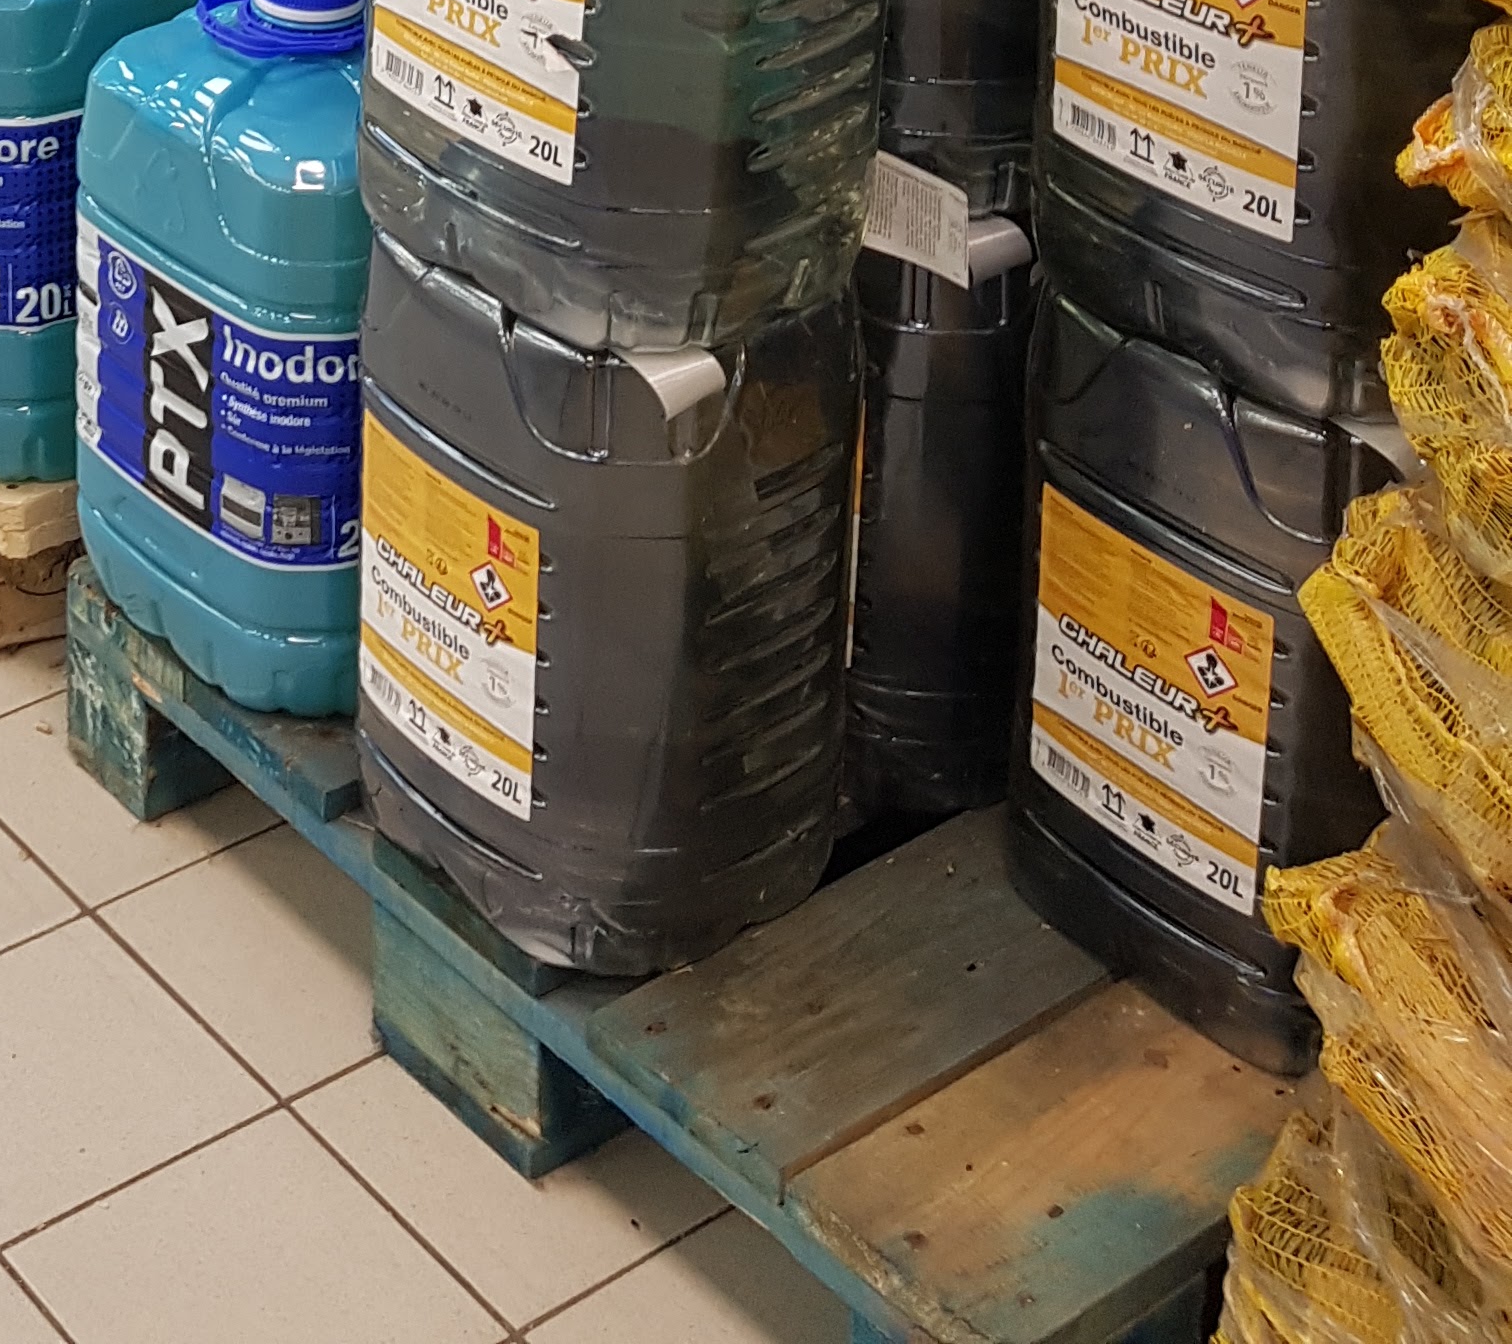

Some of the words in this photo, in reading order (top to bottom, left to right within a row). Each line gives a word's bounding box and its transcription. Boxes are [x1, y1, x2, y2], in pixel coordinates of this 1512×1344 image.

[1081, 16, 1112, 46] 1er
[1119, 34, 1208, 100] PRIX
[528, 135, 563, 168] 20L
[1241, 188, 1284, 224] 20L
[221, 323, 362, 385] Inodor
[149, 284, 210, 512] PTX
[263, 393, 329, 409] premium
[371, 564, 471, 661] Combustible
[377, 534, 483, 638] CHALEUR
[400, 614, 464, 686] PRIX
[1059, 613, 1202, 723] CHALEUR
[1051, 644, 1185, 747] Combustible
[1091, 697, 1178, 773] PRIX
[491, 769, 523, 805] 20L
[1206, 859, 1245, 900] 20L
